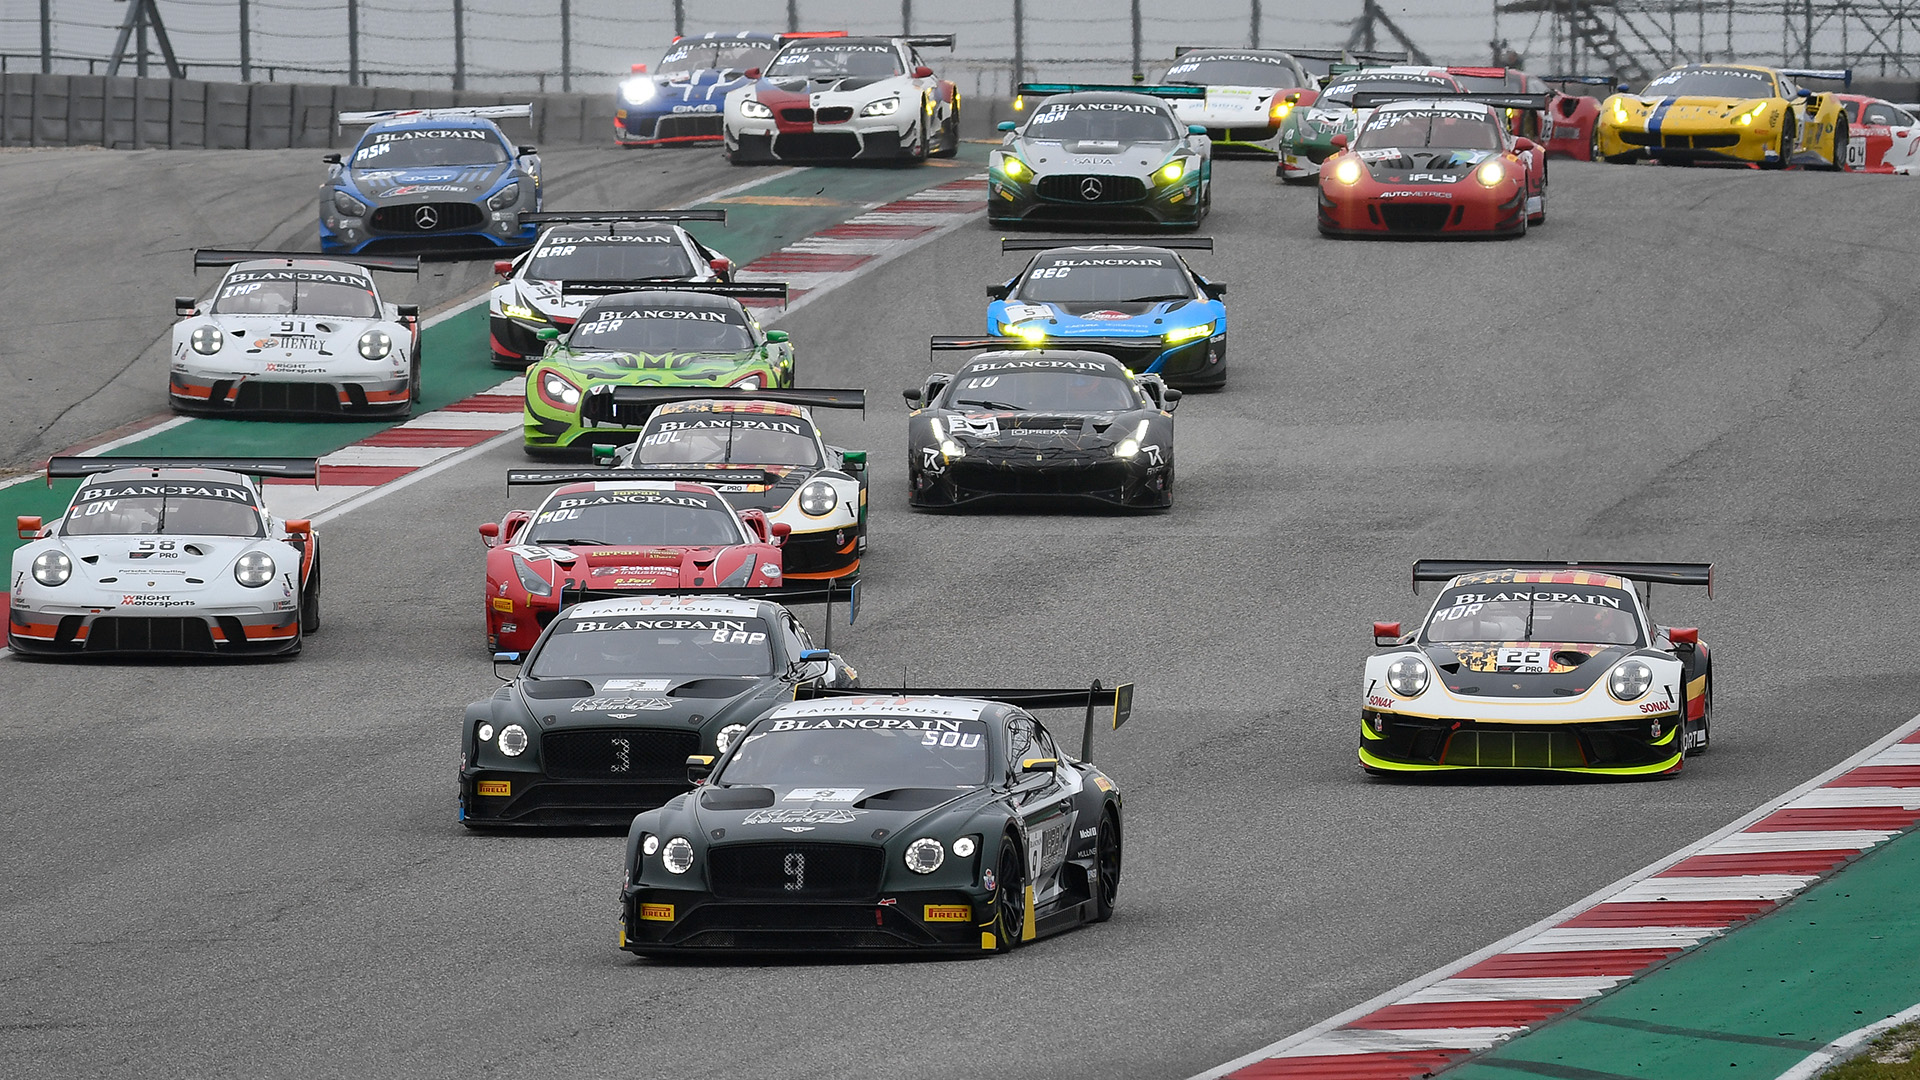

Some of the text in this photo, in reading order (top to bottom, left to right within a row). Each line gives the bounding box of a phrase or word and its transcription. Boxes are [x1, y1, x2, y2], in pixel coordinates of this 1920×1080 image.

[678, 41, 771, 53] BLANCPAIN
[789, 45, 888, 55] BLANCPAIN
[1183, 54, 1281, 65] BLANCPAIN
[1342, 74, 1446, 86] BLANCPAIN
[1051, 103, 1157, 116] BLANCPAIN
[1378, 111, 1486, 123] BLANCPAIN
[375, 130, 486, 144] BLANCPAIN
[1380, 190, 1453, 199] AUTOMETRICS
[550, 235, 672, 245] BLANCPAIN
[536, 245, 577, 259] BAR
[1053, 259, 1163, 267] BLANCPAIN
[227, 272, 368, 288] BLANCPAIN
[221, 283, 262, 299] IMP
[599, 310, 727, 323] BLANCPAIN
[280, 320, 306, 333] 91
[280, 337, 327, 351] HENRY
[970, 360, 1106, 373] BLANCPAIN
[659, 420, 800, 436] BLANCPAIN
[81, 486, 249, 502] BLANCPAIN
[559, 495, 708, 509] BLANCPAIN
[138, 540, 176, 551] 58
[620, 565, 680, 574] Zekelman
[121, 599, 196, 608] Motorsports
[1453, 592, 1621, 609] BLANCPAIN
[592, 606, 734, 615] FAMILY HOUSE
[1431, 602, 1484, 624] MOR
[573, 620, 747, 633] BLANCPAIN
[1506, 651, 1541, 664] 22
[1368, 695, 1396, 708] SONAX
[1639, 700, 1671, 714] SONAX
[796, 706, 953, 715] FAMILY HOUSE
[769, 719, 964, 732] BLANCPAIN
[479, 783, 508, 793] PIRELLI
[784, 853, 806, 891] 9
[641, 908, 671, 918] PIRELLI
[928, 907, 969, 919] PIRELLI
